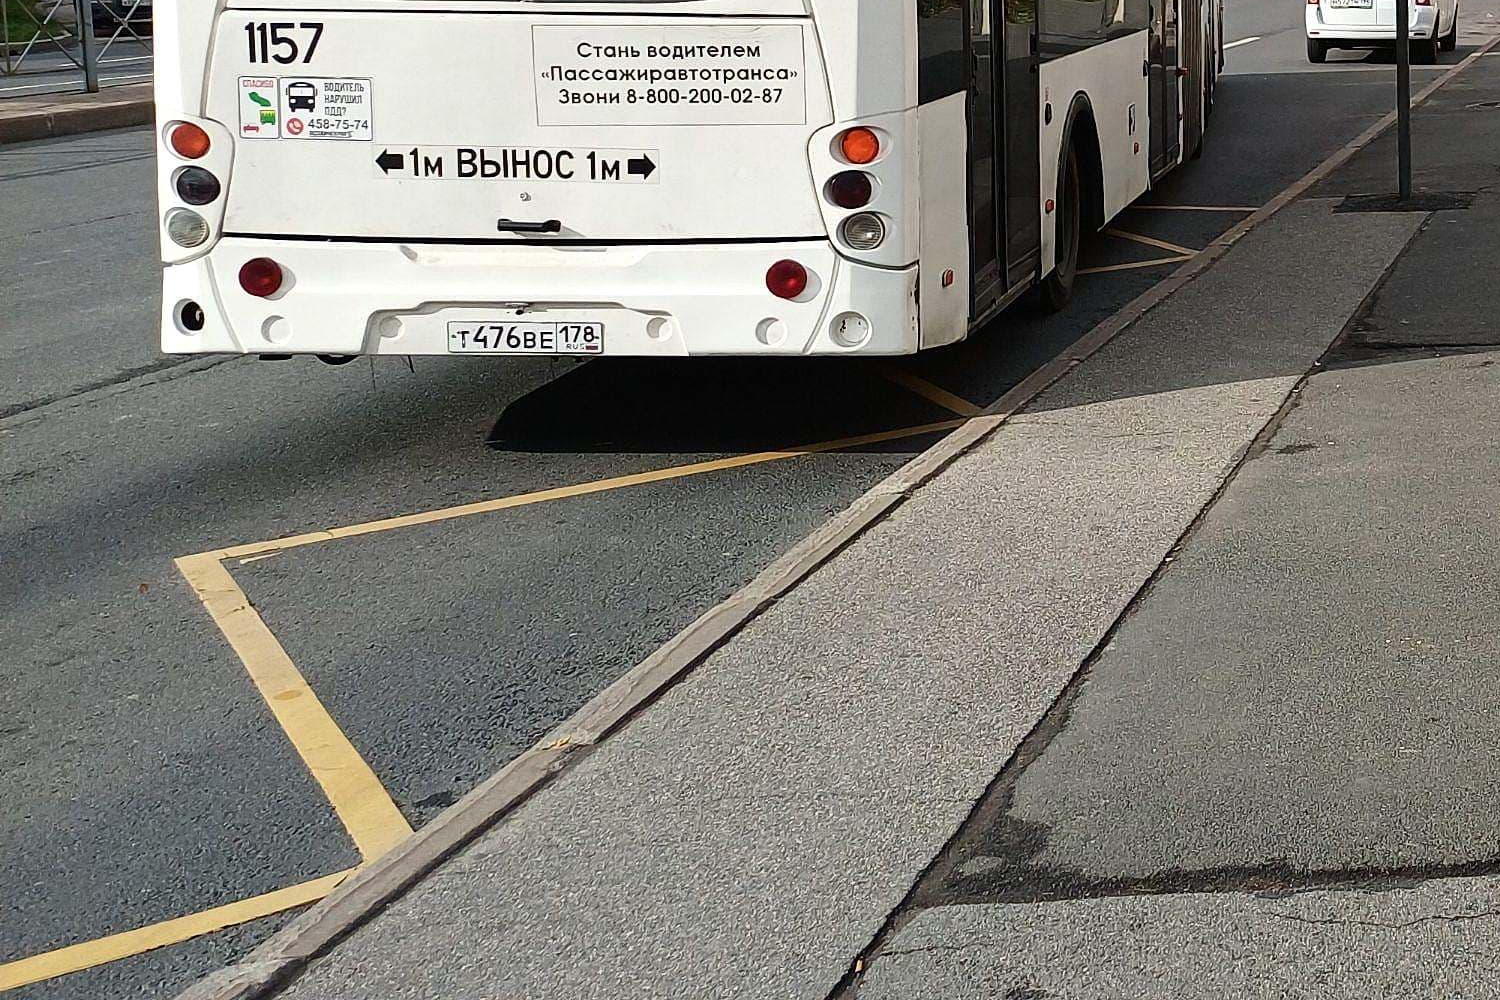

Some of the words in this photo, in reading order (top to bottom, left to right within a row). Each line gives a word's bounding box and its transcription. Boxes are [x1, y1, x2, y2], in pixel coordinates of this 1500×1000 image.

[244, 21, 324, 64] 1157
[576, 42, 640, 58] Стань
[647, 43, 761, 60] водителем
[541, 66, 798, 84] «Пассажиравтотранса»
[324, 82, 365, 92] ВОДИТЕЛЬ
[558, 88, 620, 104] Звони
[626, 87, 783, 104] 8-800-200-02-87
[324, 94, 363, 104] НАРУШИЛ
[307, 119, 369, 130] 458-75-74
[409, 148, 443, 177] 1м
[456, 148, 574, 179] ВЫНОС
[586, 151, 620, 180] 1м
[457, 326, 553, 348] Т476ВЕ
[559, 326, 595, 342] 178
